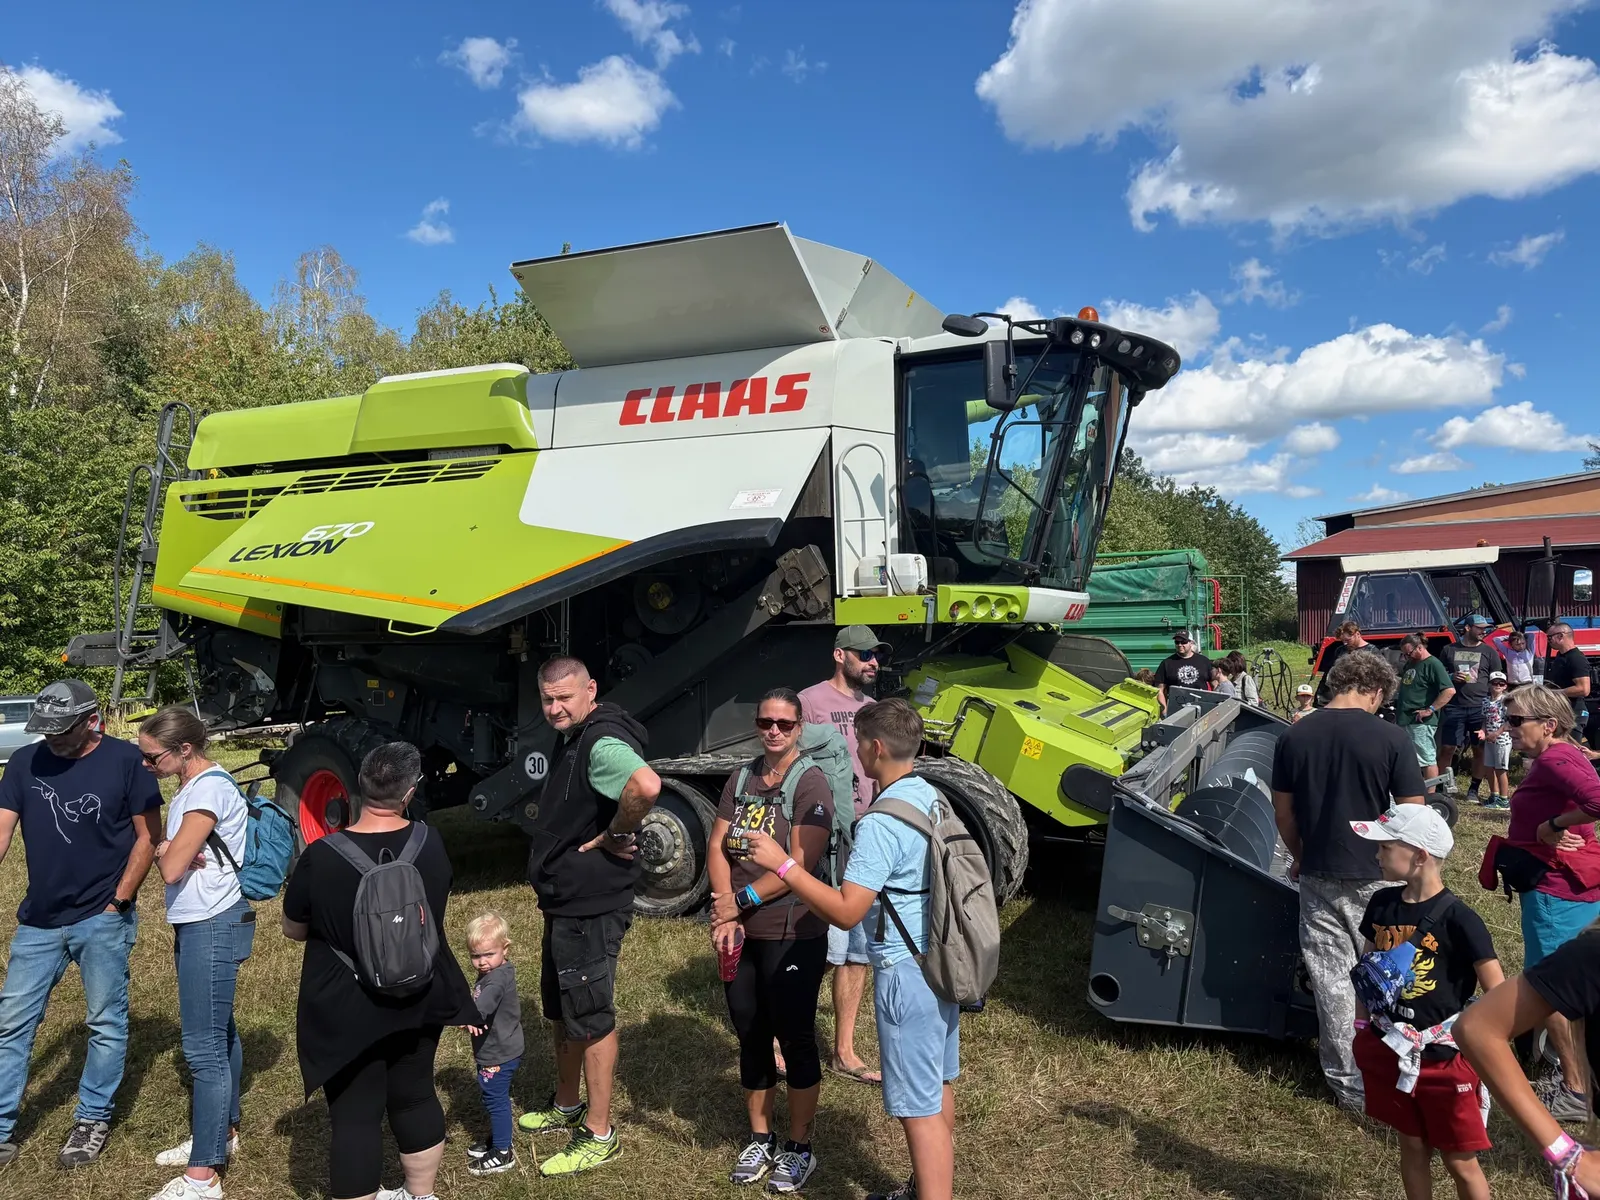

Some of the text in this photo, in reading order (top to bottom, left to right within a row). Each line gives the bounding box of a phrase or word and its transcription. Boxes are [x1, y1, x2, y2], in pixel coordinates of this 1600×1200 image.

[619, 372, 811, 426] CLAAS
[301, 521, 376, 542] 670
[228, 537, 348, 563] LEXION
[1337, 577, 1354, 613] SPECIAL
[528, 757, 544, 775] 30
